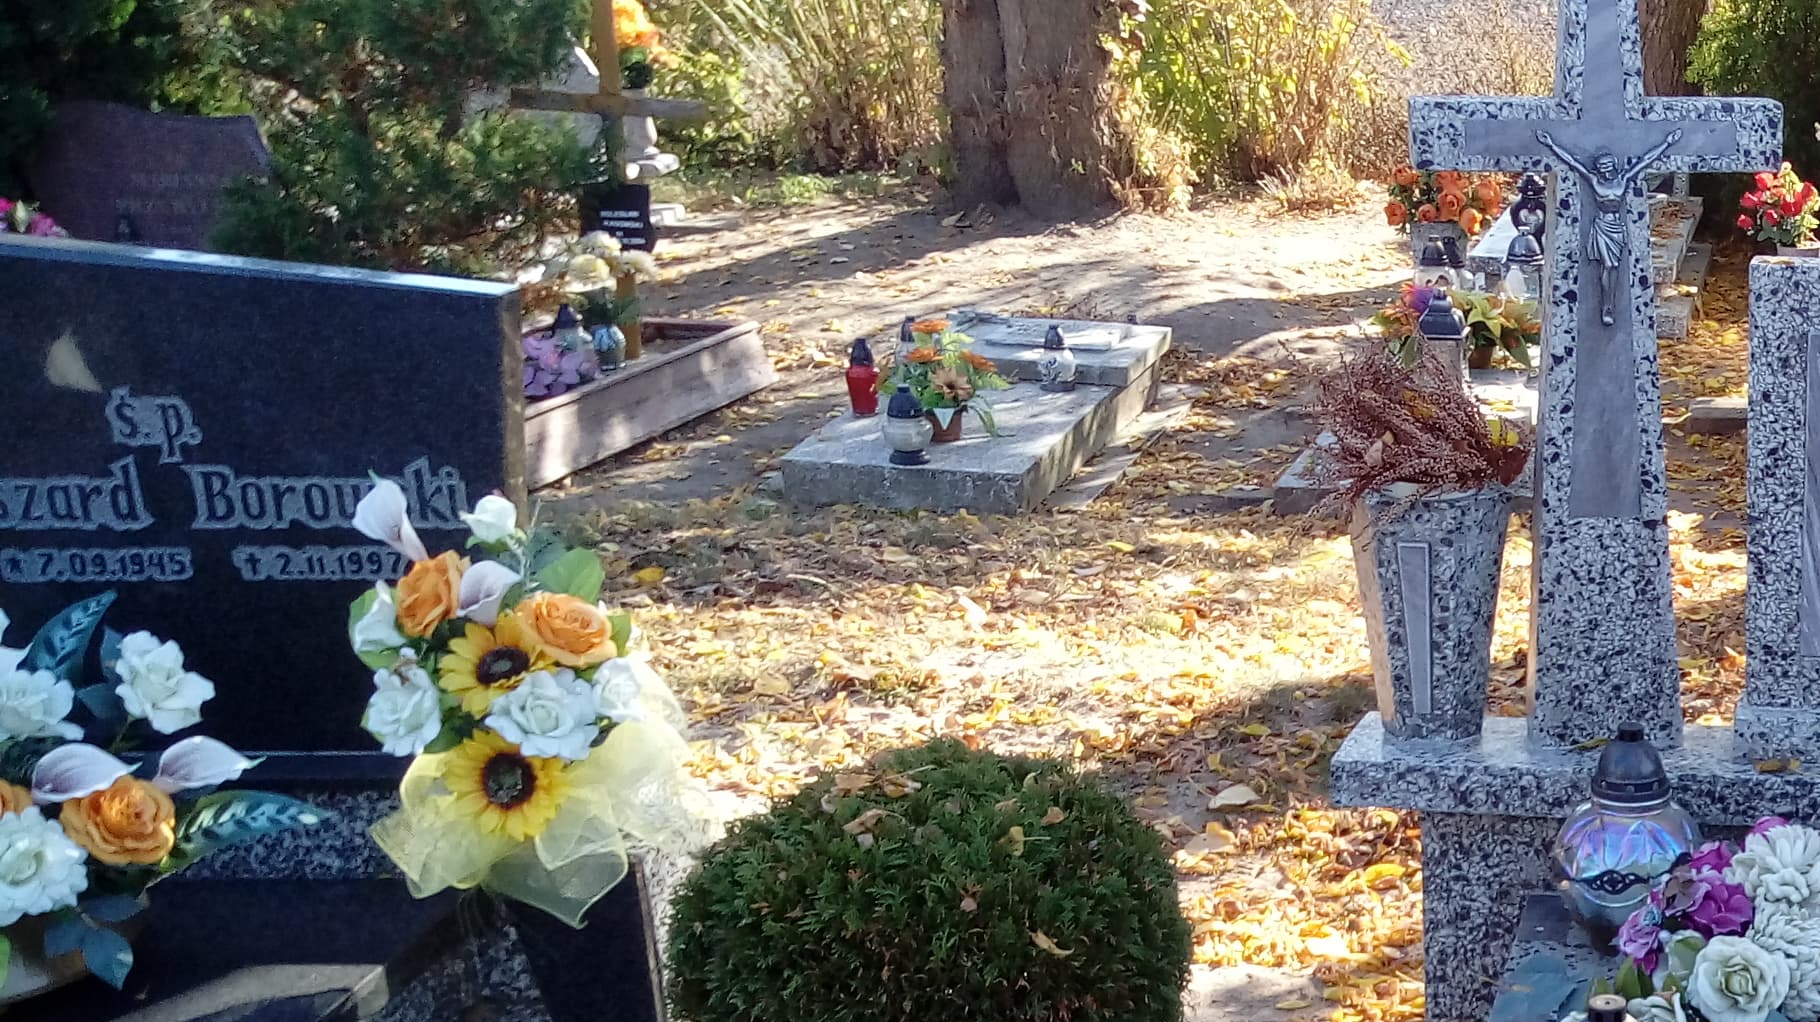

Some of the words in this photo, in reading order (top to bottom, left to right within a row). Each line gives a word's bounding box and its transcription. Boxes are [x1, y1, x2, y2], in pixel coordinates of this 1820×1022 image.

[202, 467, 461, 523] Borowki
[37, 552, 187, 578] 7.09.1945
[277, 550, 402, 576] 2.11.1997
